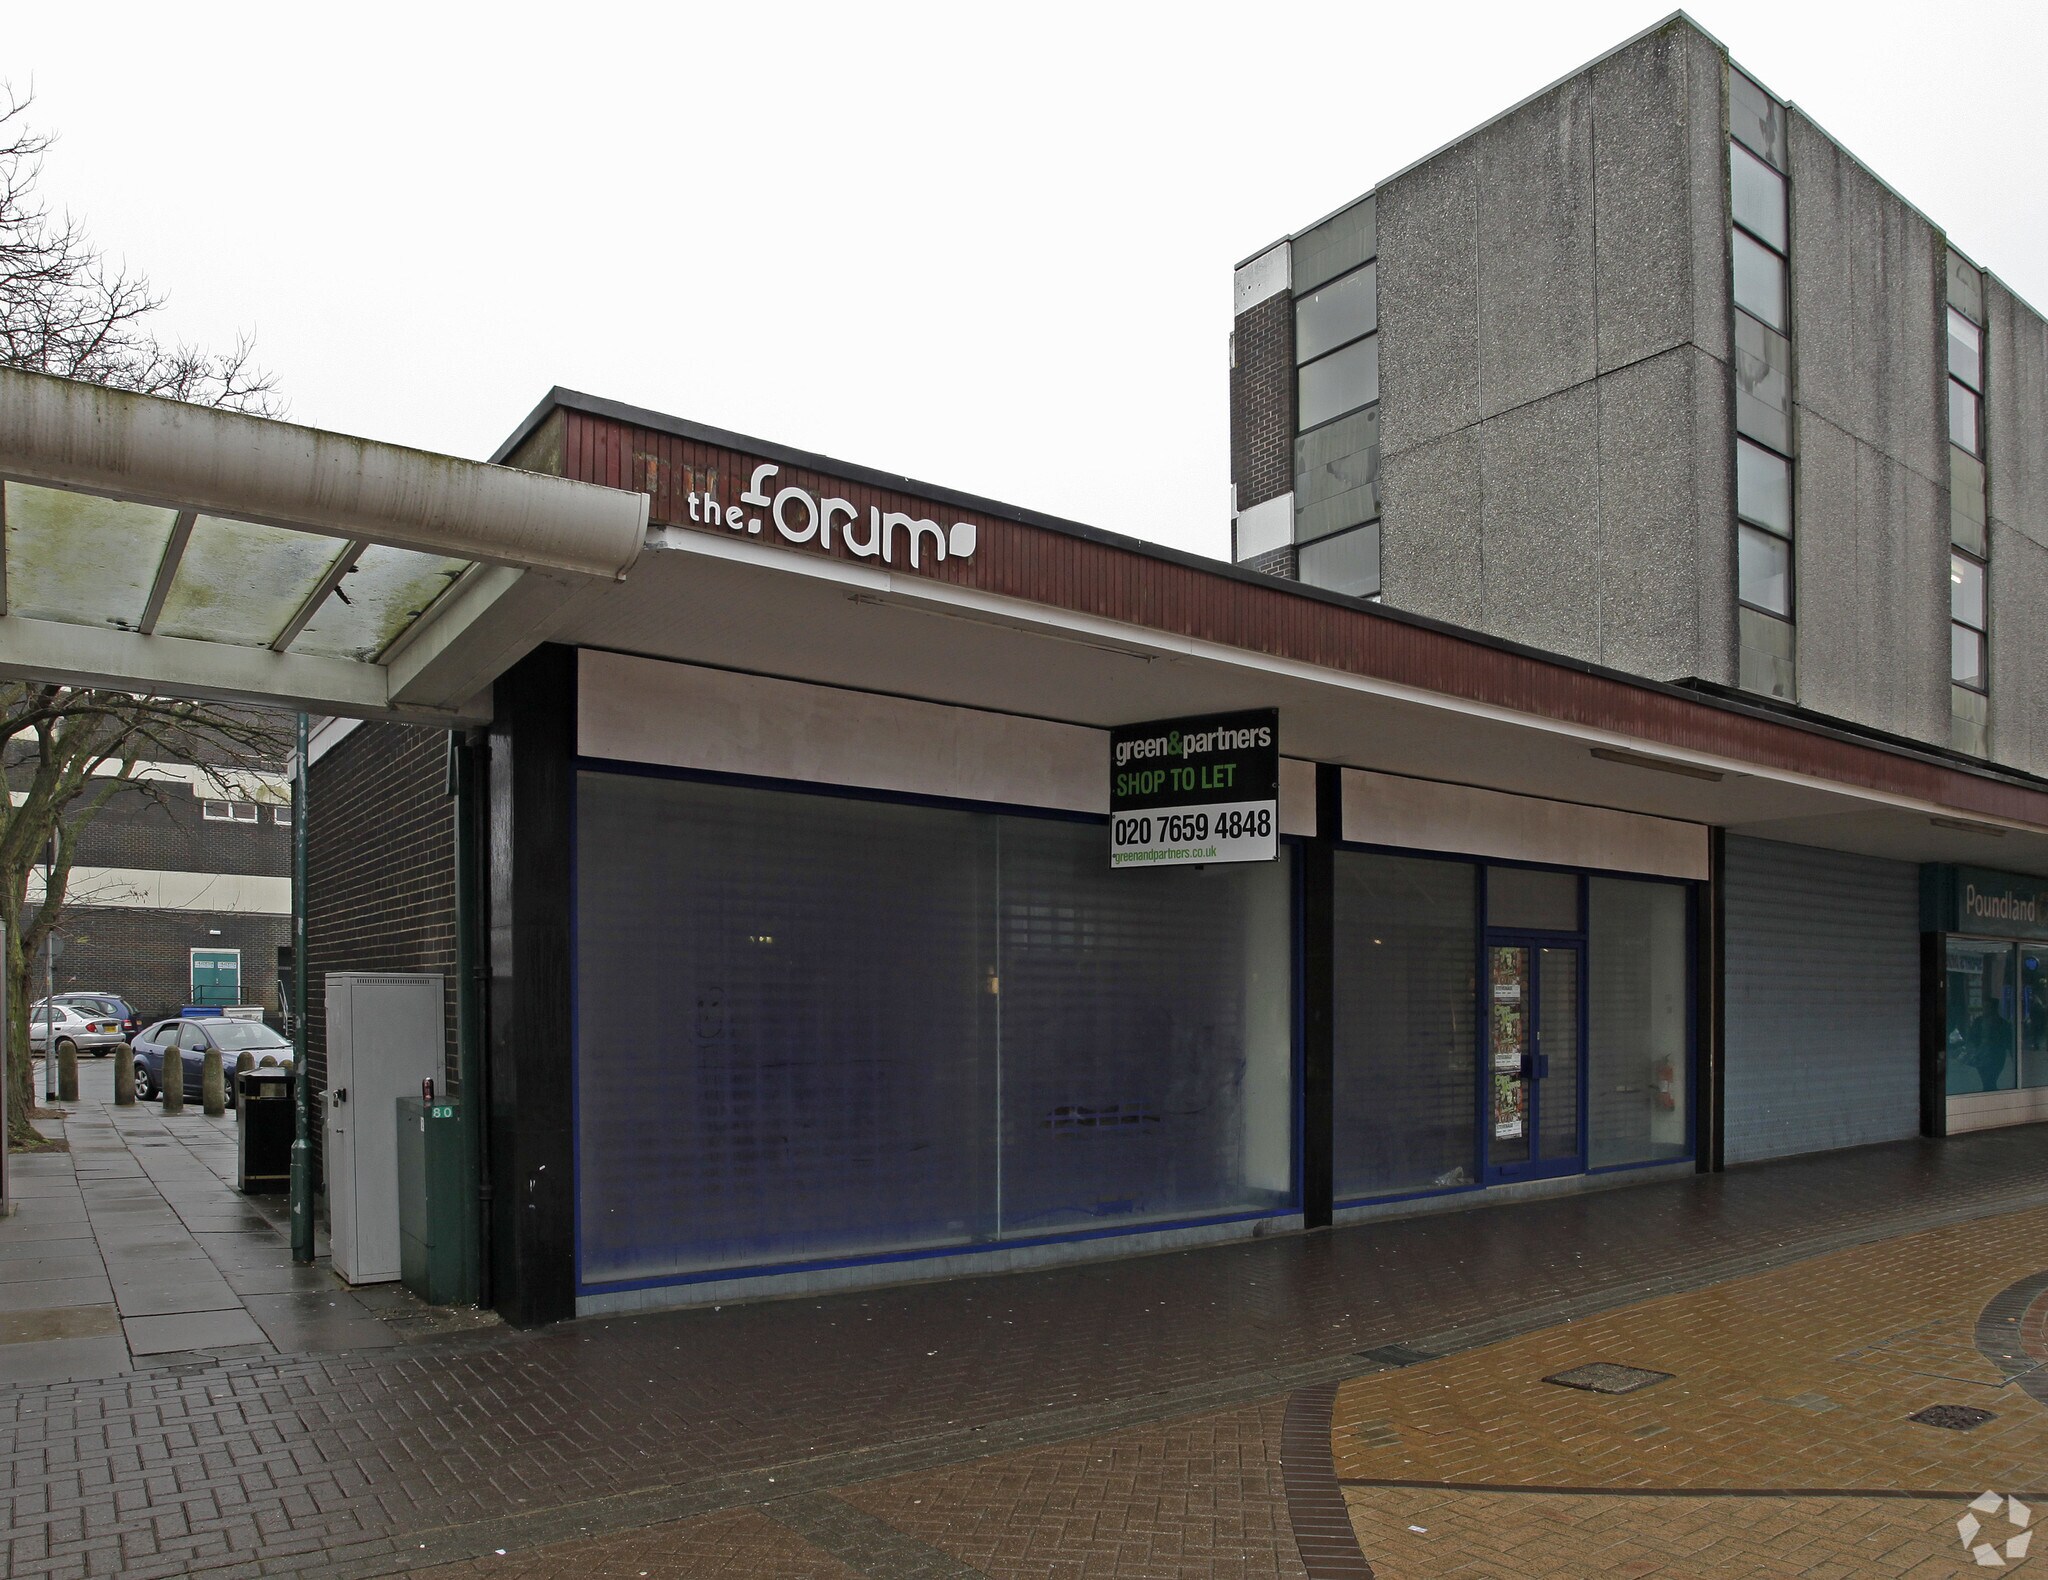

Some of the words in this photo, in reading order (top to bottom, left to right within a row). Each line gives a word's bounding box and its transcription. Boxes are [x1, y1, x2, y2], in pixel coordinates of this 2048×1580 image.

[688, 491, 744, 530] the
[741, 463, 946, 569] forum
[1116, 770, 1166, 797] SHOP
[1170, 767, 1196, 792] TO
[1201, 763, 1237, 790] LET
[1115, 817, 1152, 846] 020
[1157, 813, 1209, 843] 7659
[1214, 809, 1272, 840] 4848
[1115, 846, 1217, 865] greenandpartners.co.uk
[1966, 884, 2036, 922] Poundland
